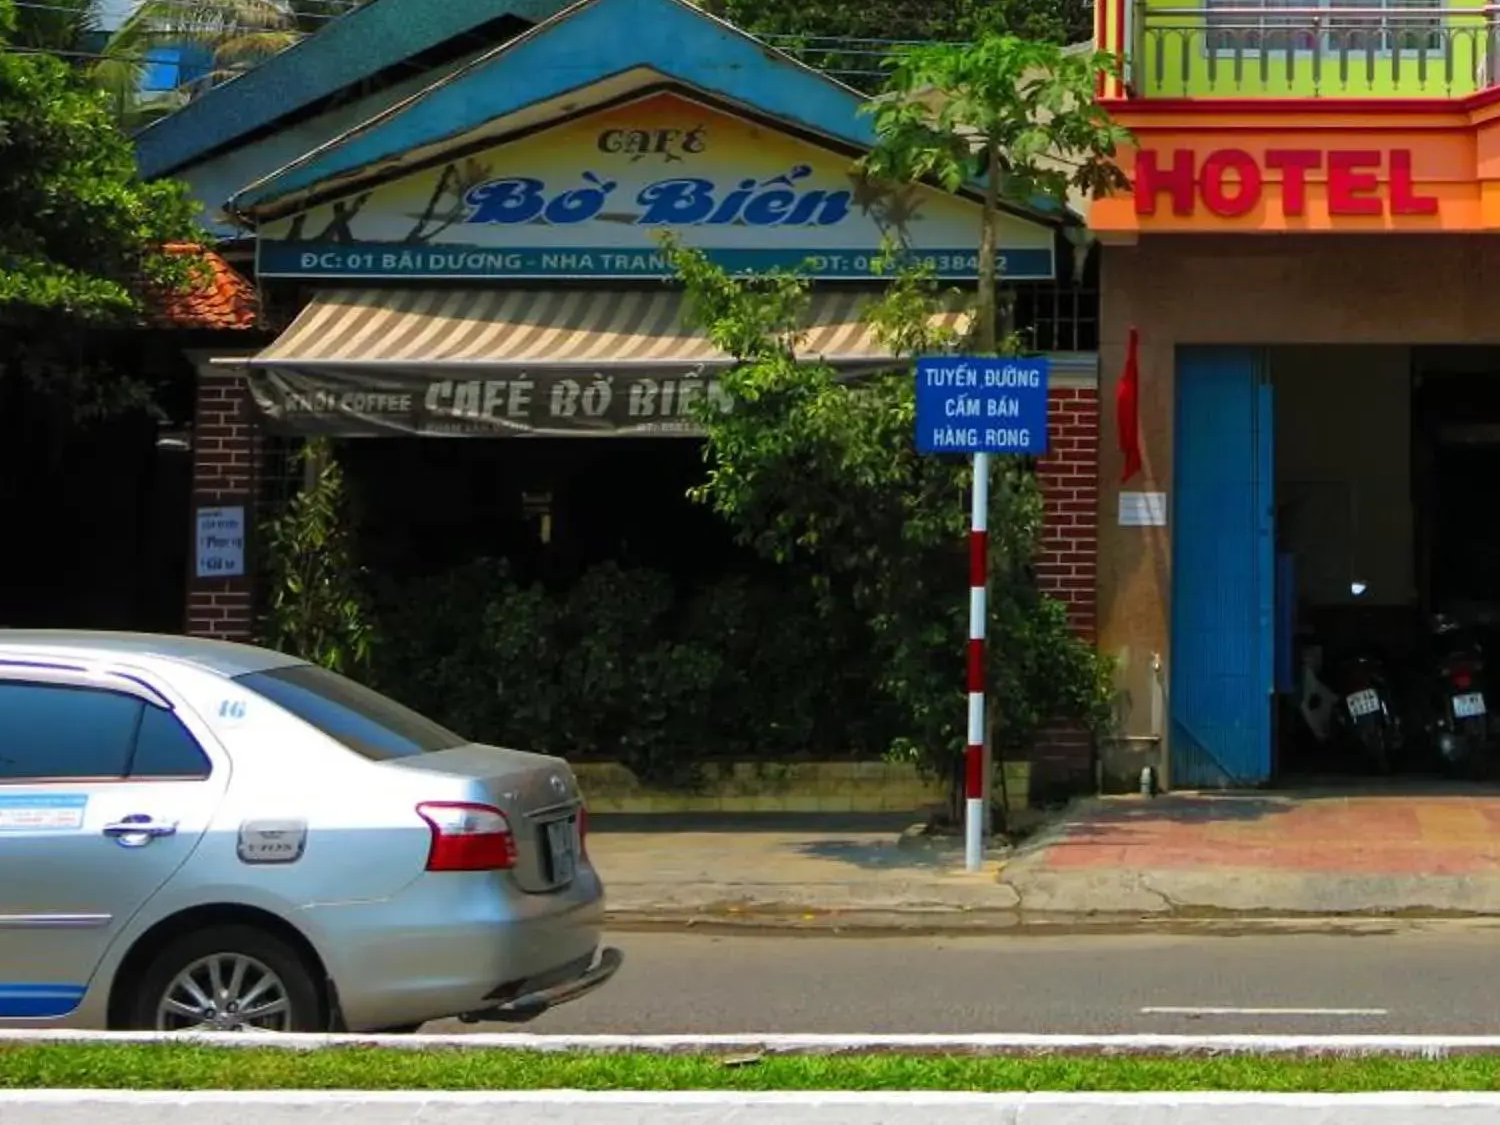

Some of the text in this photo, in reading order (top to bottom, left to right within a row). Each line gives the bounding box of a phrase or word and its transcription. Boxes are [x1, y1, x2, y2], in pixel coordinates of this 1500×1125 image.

[597, 124, 707, 153] CAFÉ
[464, 170, 617, 226] Bờ
[1134, 149, 1438, 216] HOTEL
[347, 252, 373, 269] 01
[542, 253, 593, 270] NHA
[425, 371, 534, 417] CAFÉ
[933, 424, 1030, 447] HÀNG RONG
